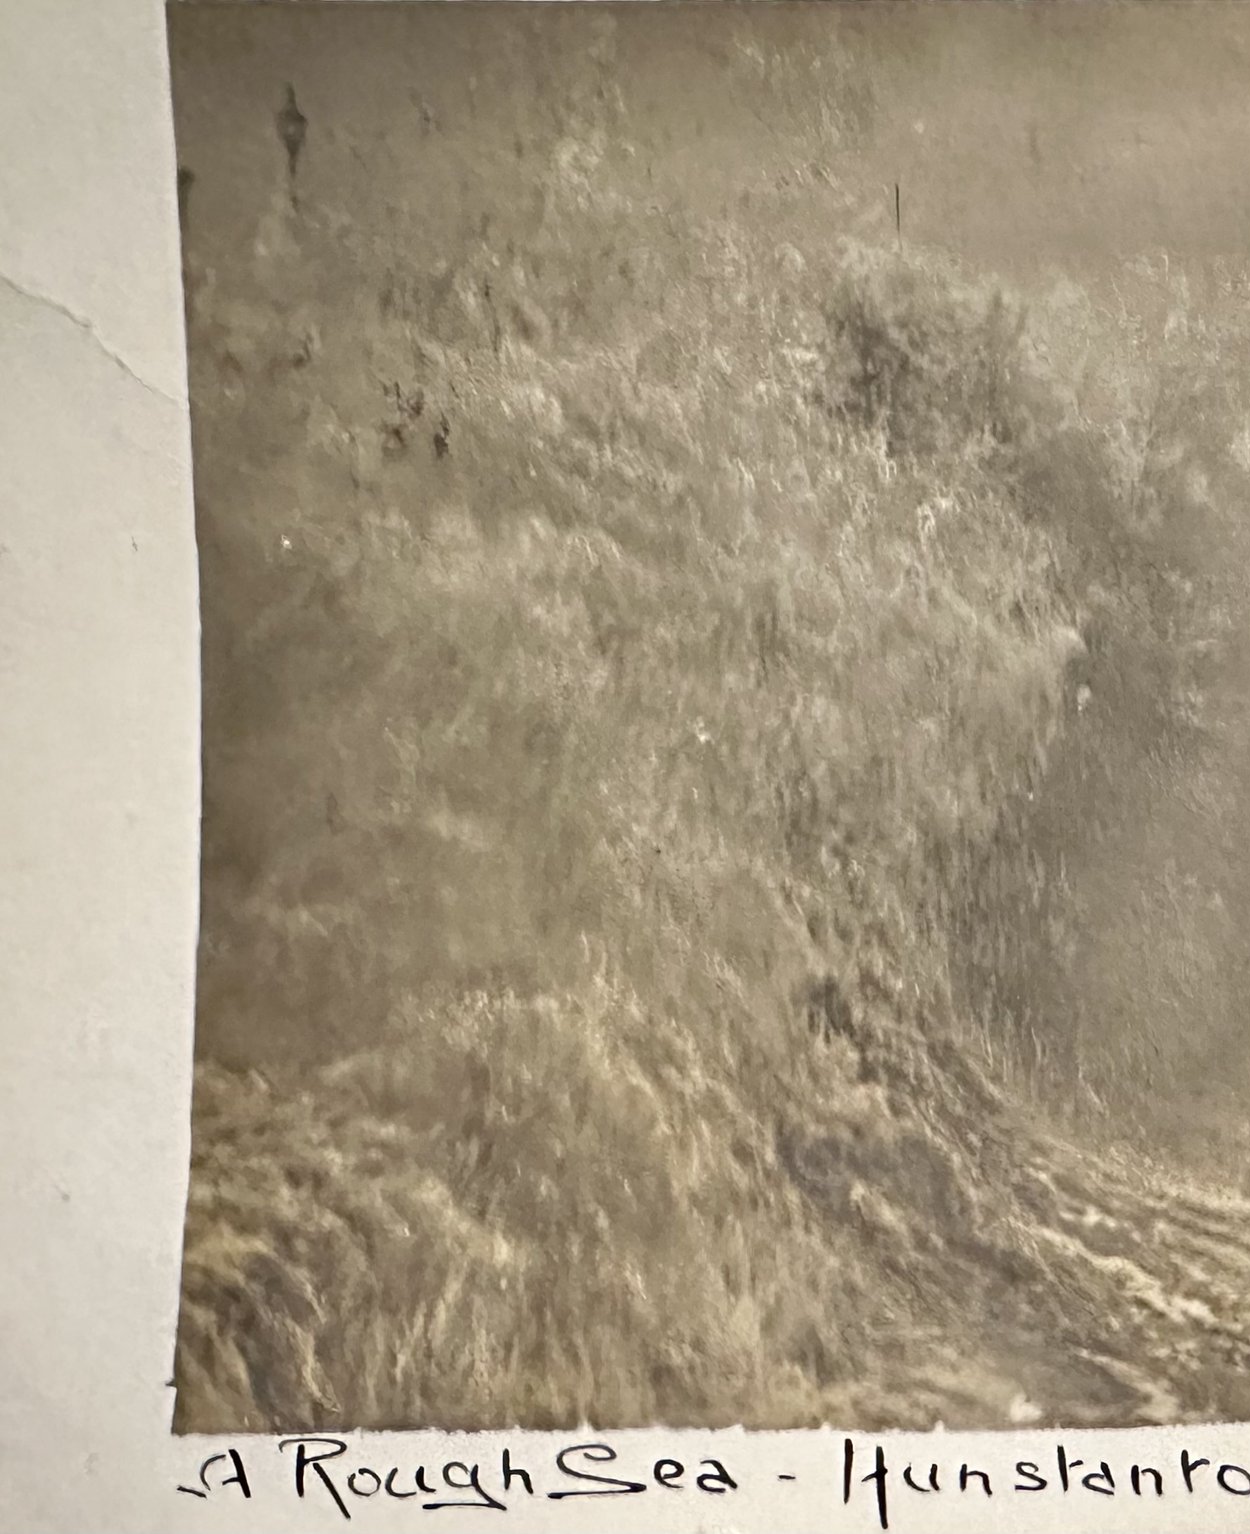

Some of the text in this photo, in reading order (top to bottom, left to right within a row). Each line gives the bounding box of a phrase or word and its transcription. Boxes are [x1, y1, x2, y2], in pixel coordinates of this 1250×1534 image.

[176, 1447, 252, 1499] A
[277, 1437, 534, 1521] Rough
[546, 1443, 739, 1500] Sea
